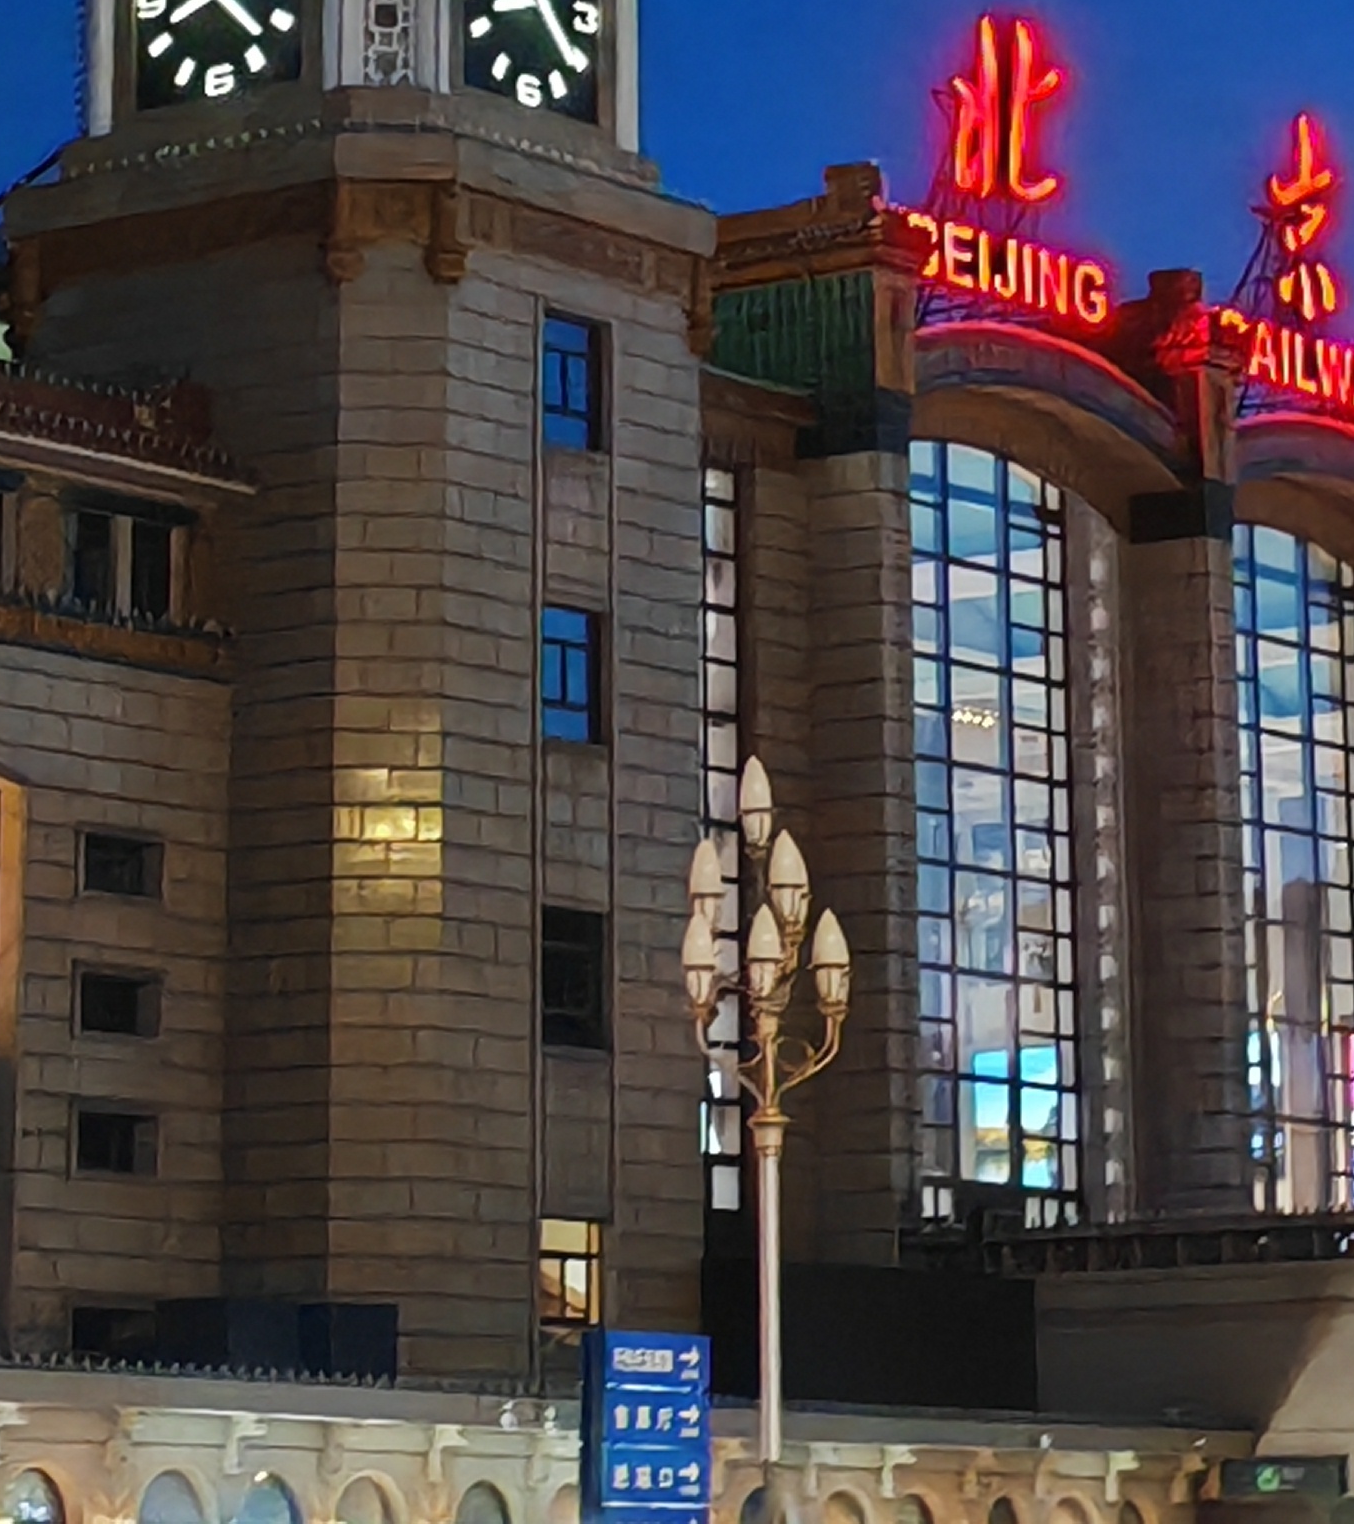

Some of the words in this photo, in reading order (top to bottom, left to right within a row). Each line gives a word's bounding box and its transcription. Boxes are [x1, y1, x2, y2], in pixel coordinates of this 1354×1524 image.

[572, 0, 602, 34] 3
[204, 62, 235, 97] 6
[516, 73, 543, 108] 6
